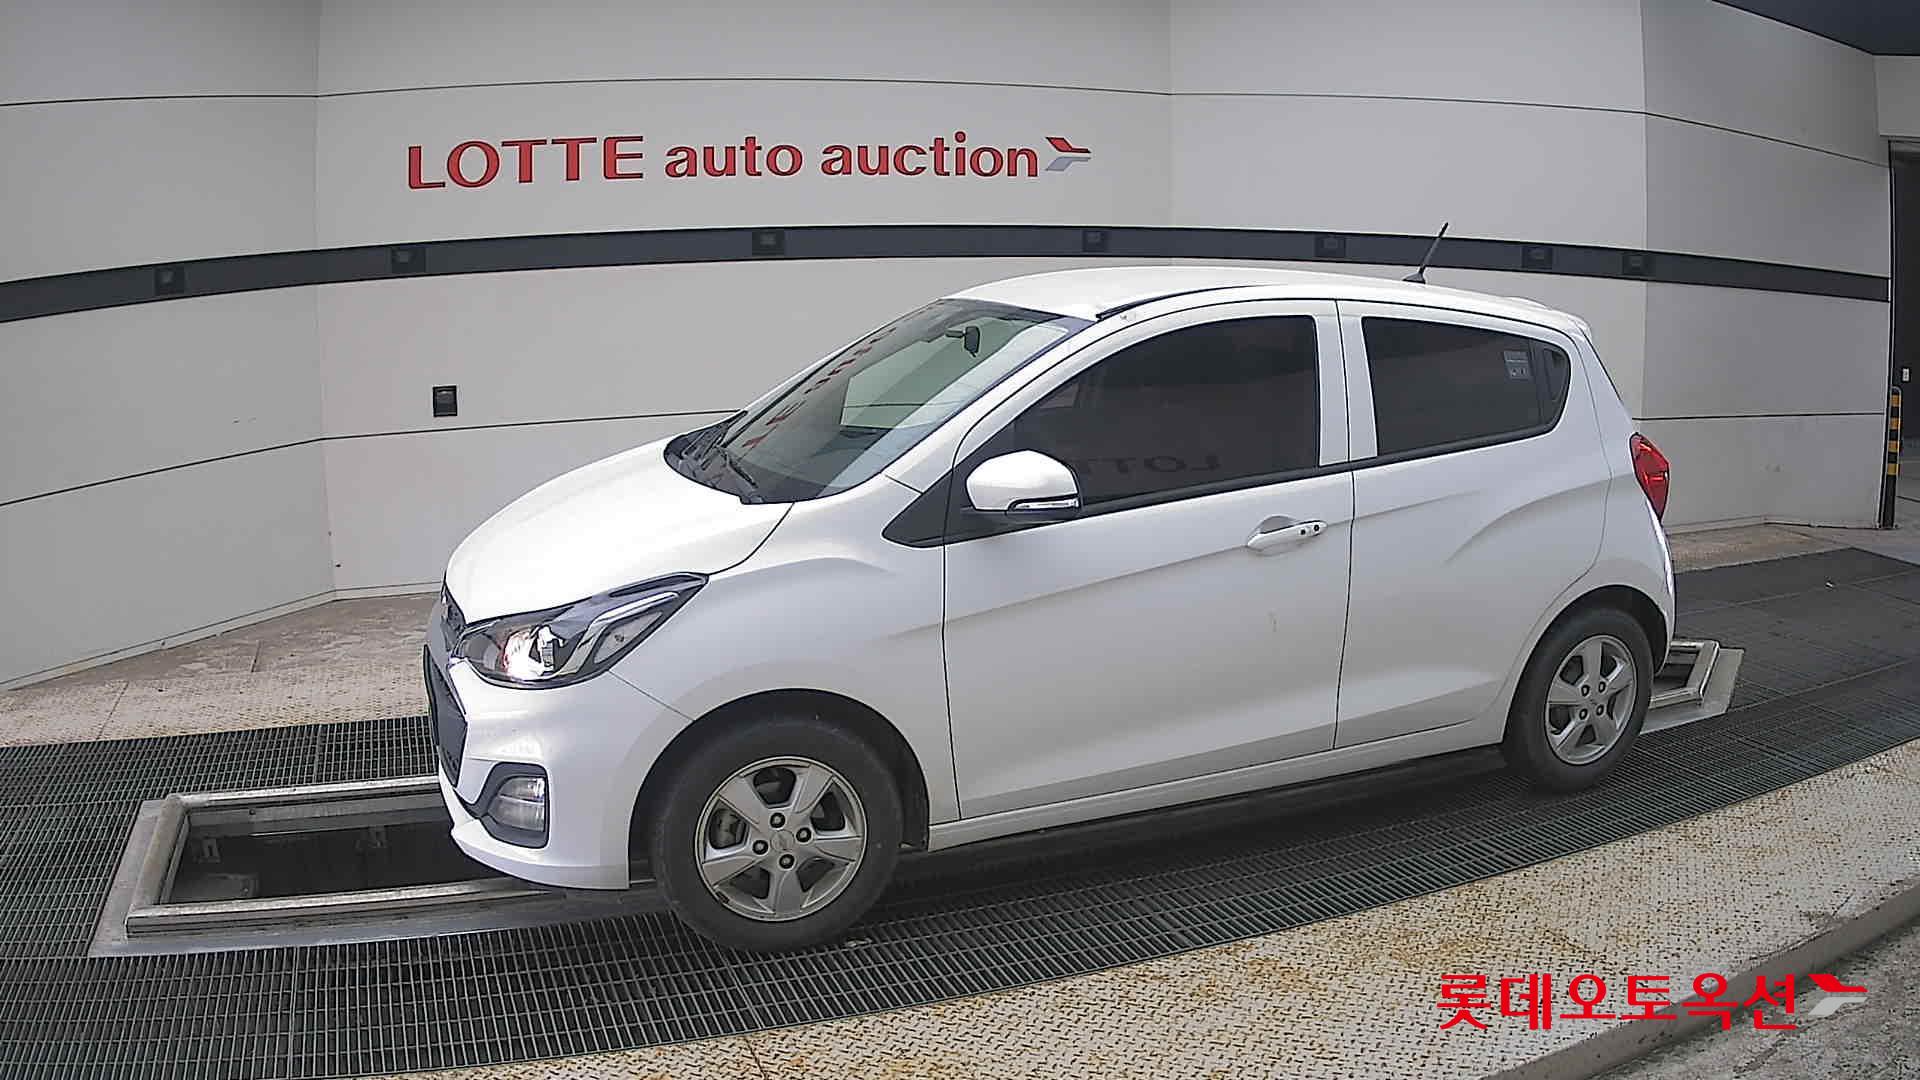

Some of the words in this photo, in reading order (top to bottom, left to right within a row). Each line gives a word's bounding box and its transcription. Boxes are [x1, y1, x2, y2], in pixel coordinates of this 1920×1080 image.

[408, 135, 644, 190] LOTTE
[664, 137, 803, 178] auto
[820, 131, 1039, 177] auction
